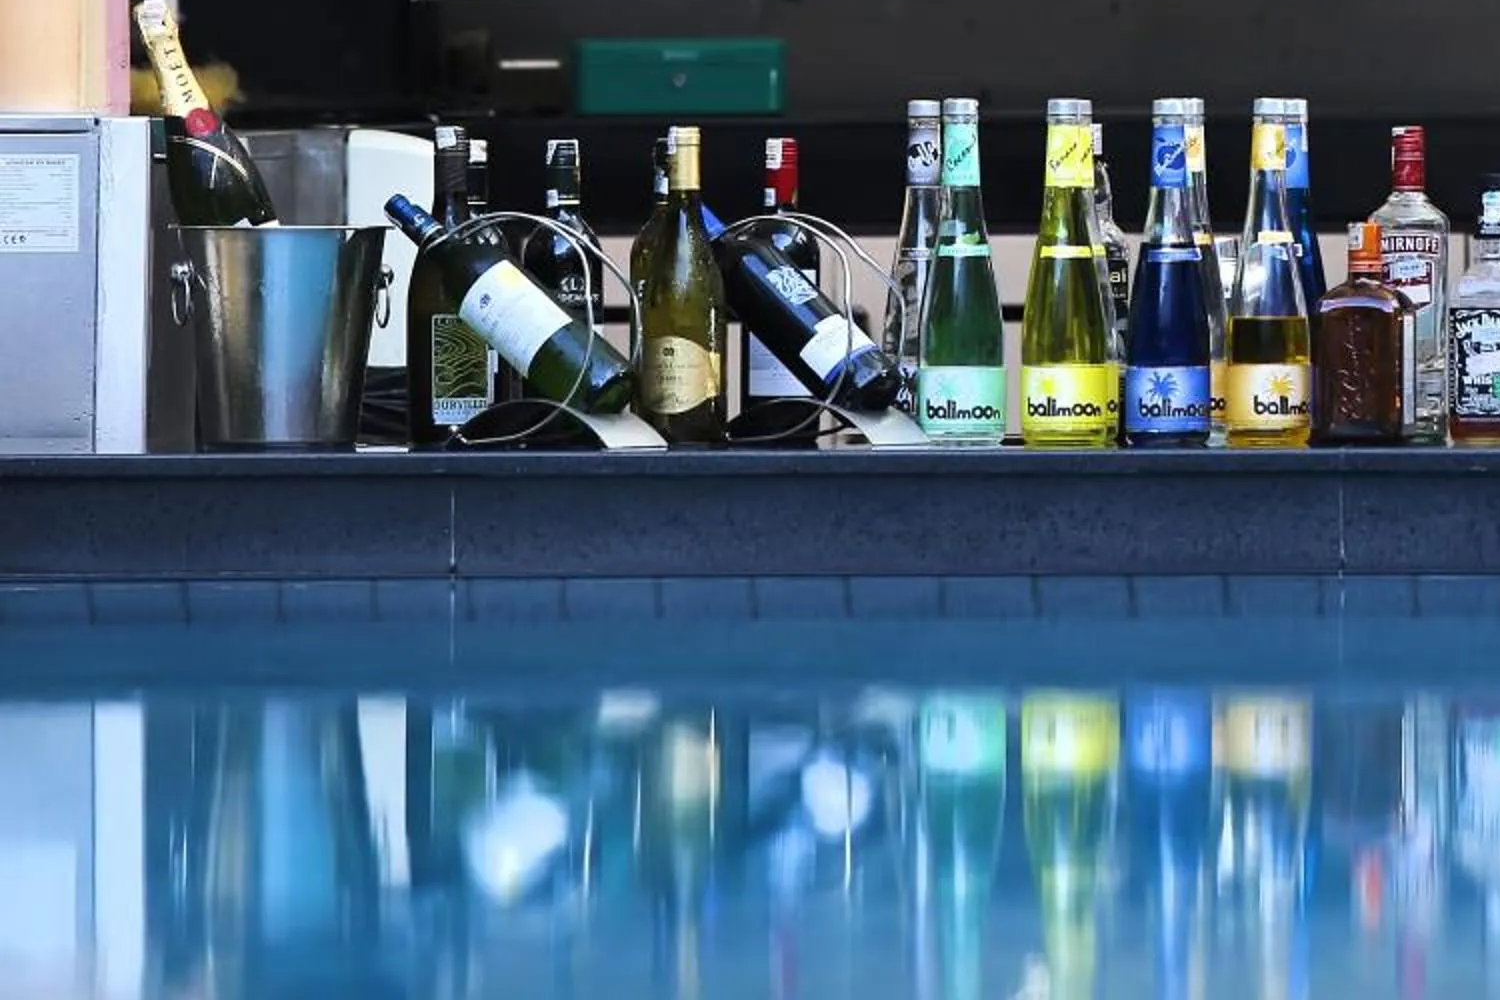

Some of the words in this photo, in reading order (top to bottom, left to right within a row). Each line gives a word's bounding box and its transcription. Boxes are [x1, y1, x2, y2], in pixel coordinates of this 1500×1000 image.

[1381, 236, 1439, 253] MIRNOFF
[926, 397, 1001, 420] balimoon
[1027, 396, 1101, 417] balimoon
[1254, 395, 1310, 416] balimo
